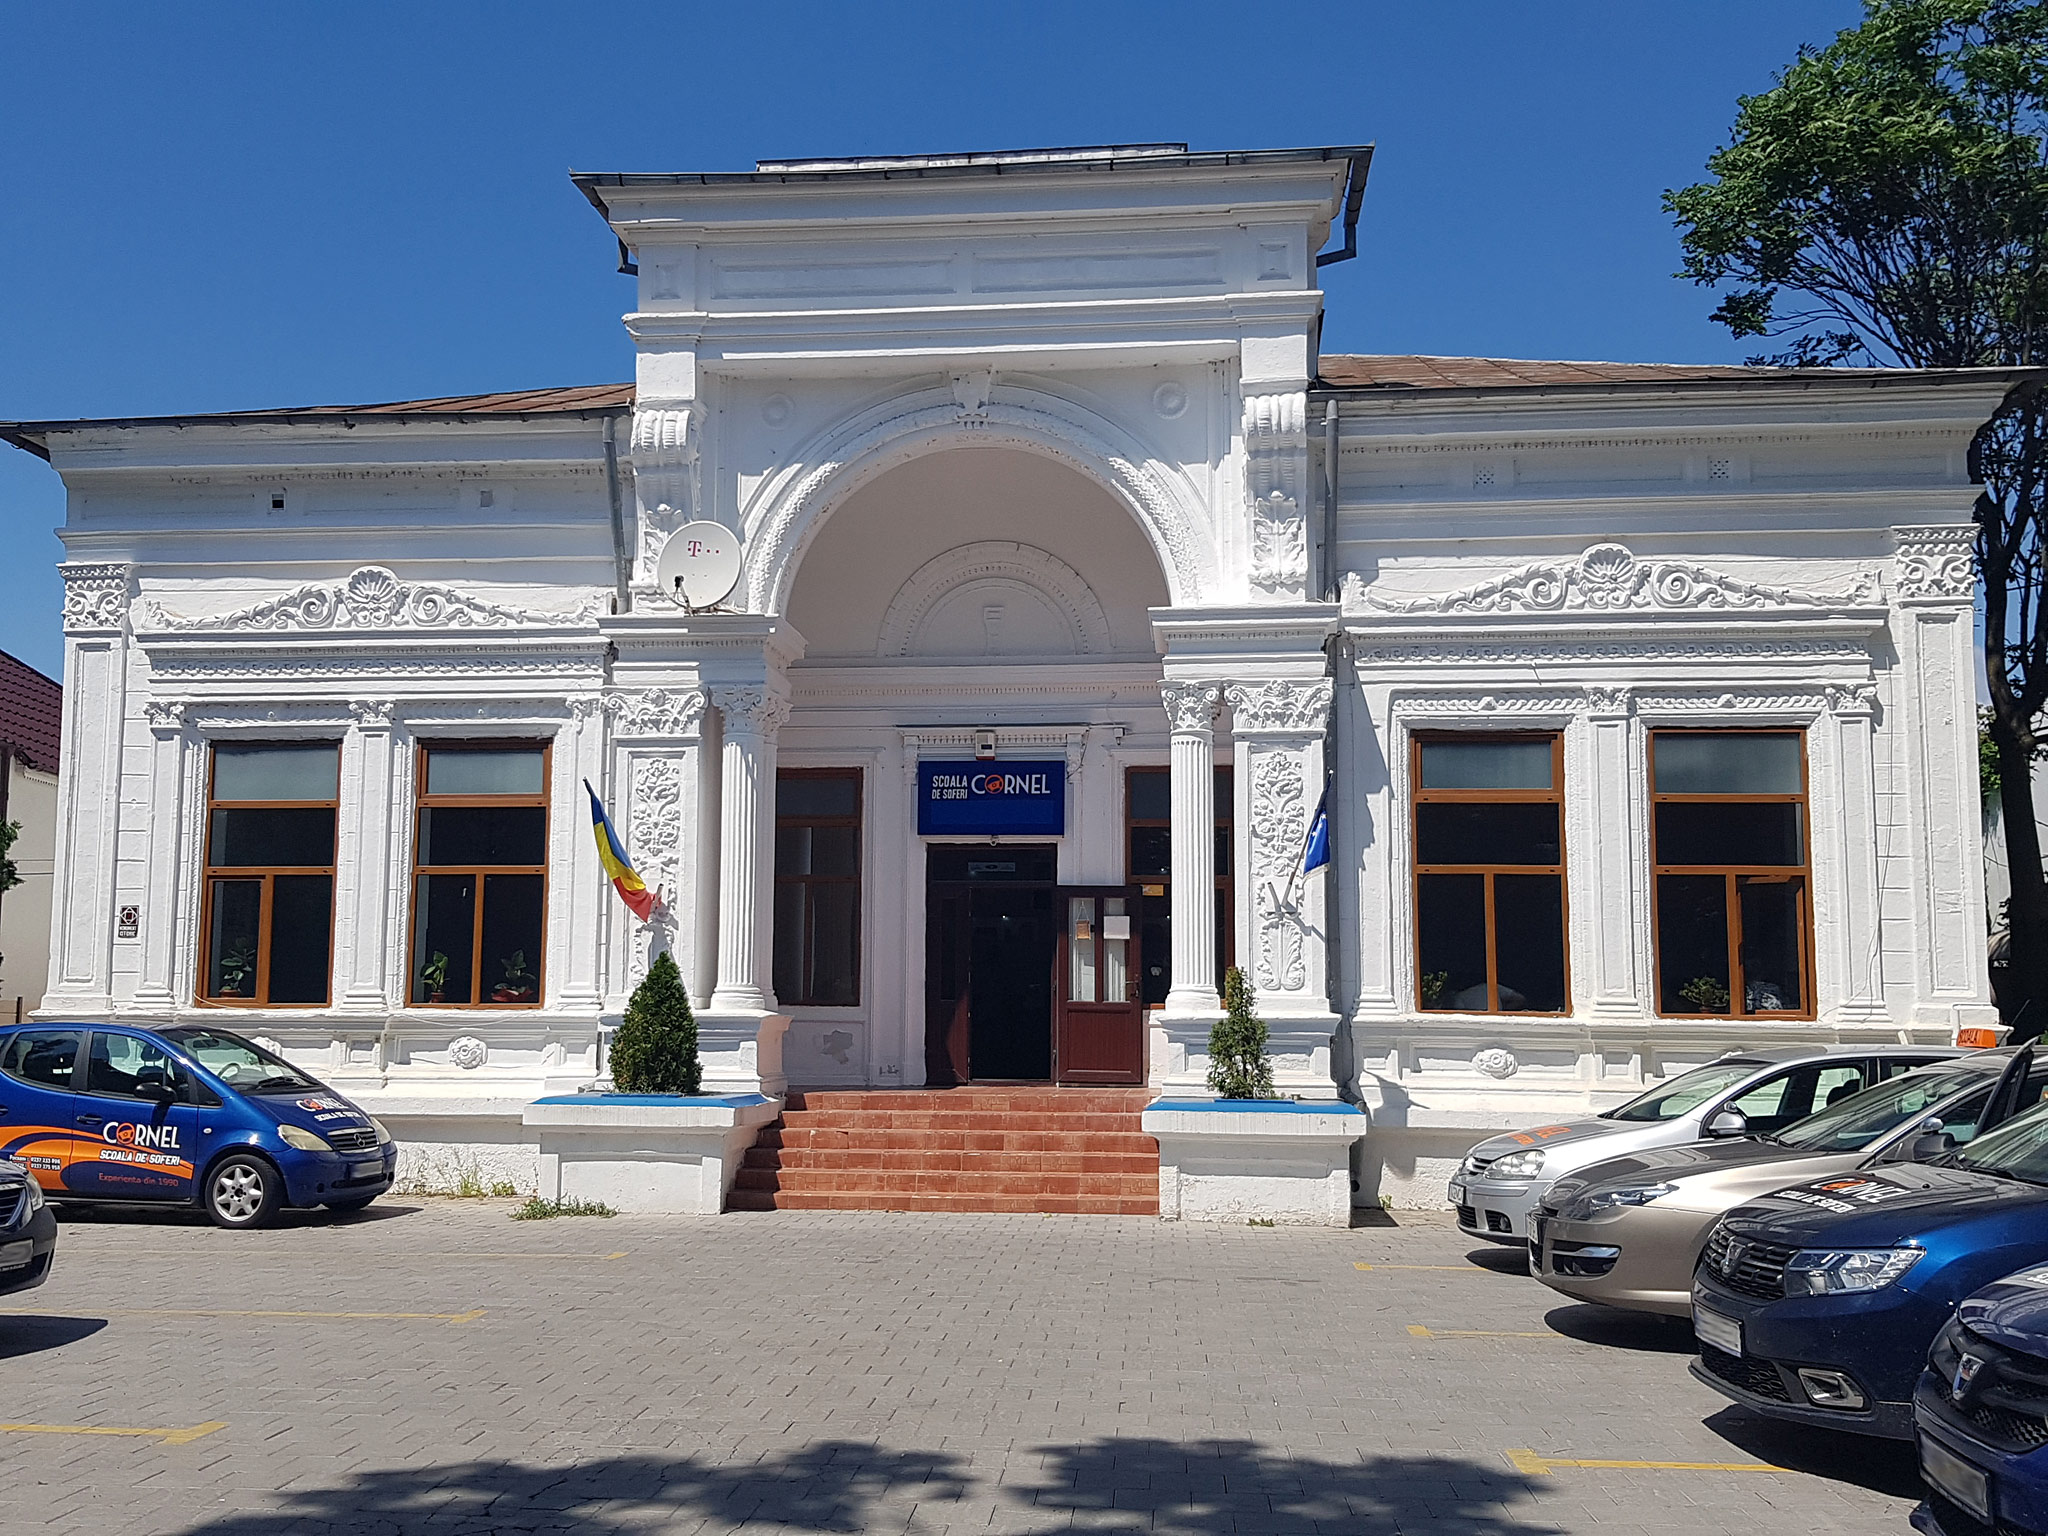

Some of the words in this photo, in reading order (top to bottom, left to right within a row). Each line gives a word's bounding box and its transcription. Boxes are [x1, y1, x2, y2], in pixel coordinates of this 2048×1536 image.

[932, 775, 968, 788] SCOALA
[971, 774, 1051, 795] CORNEL
[931, 788, 941, 800] DE
[942, 788, 968, 800] SOFERI
[103, 1121, 180, 1149] CORNEL
[100, 1150, 133, 1162] SCOALA
[135, 1152, 148, 1164] DE
[148, 1154, 181, 1166] SOFERI
[158, 1177, 179, 1187] 1990
